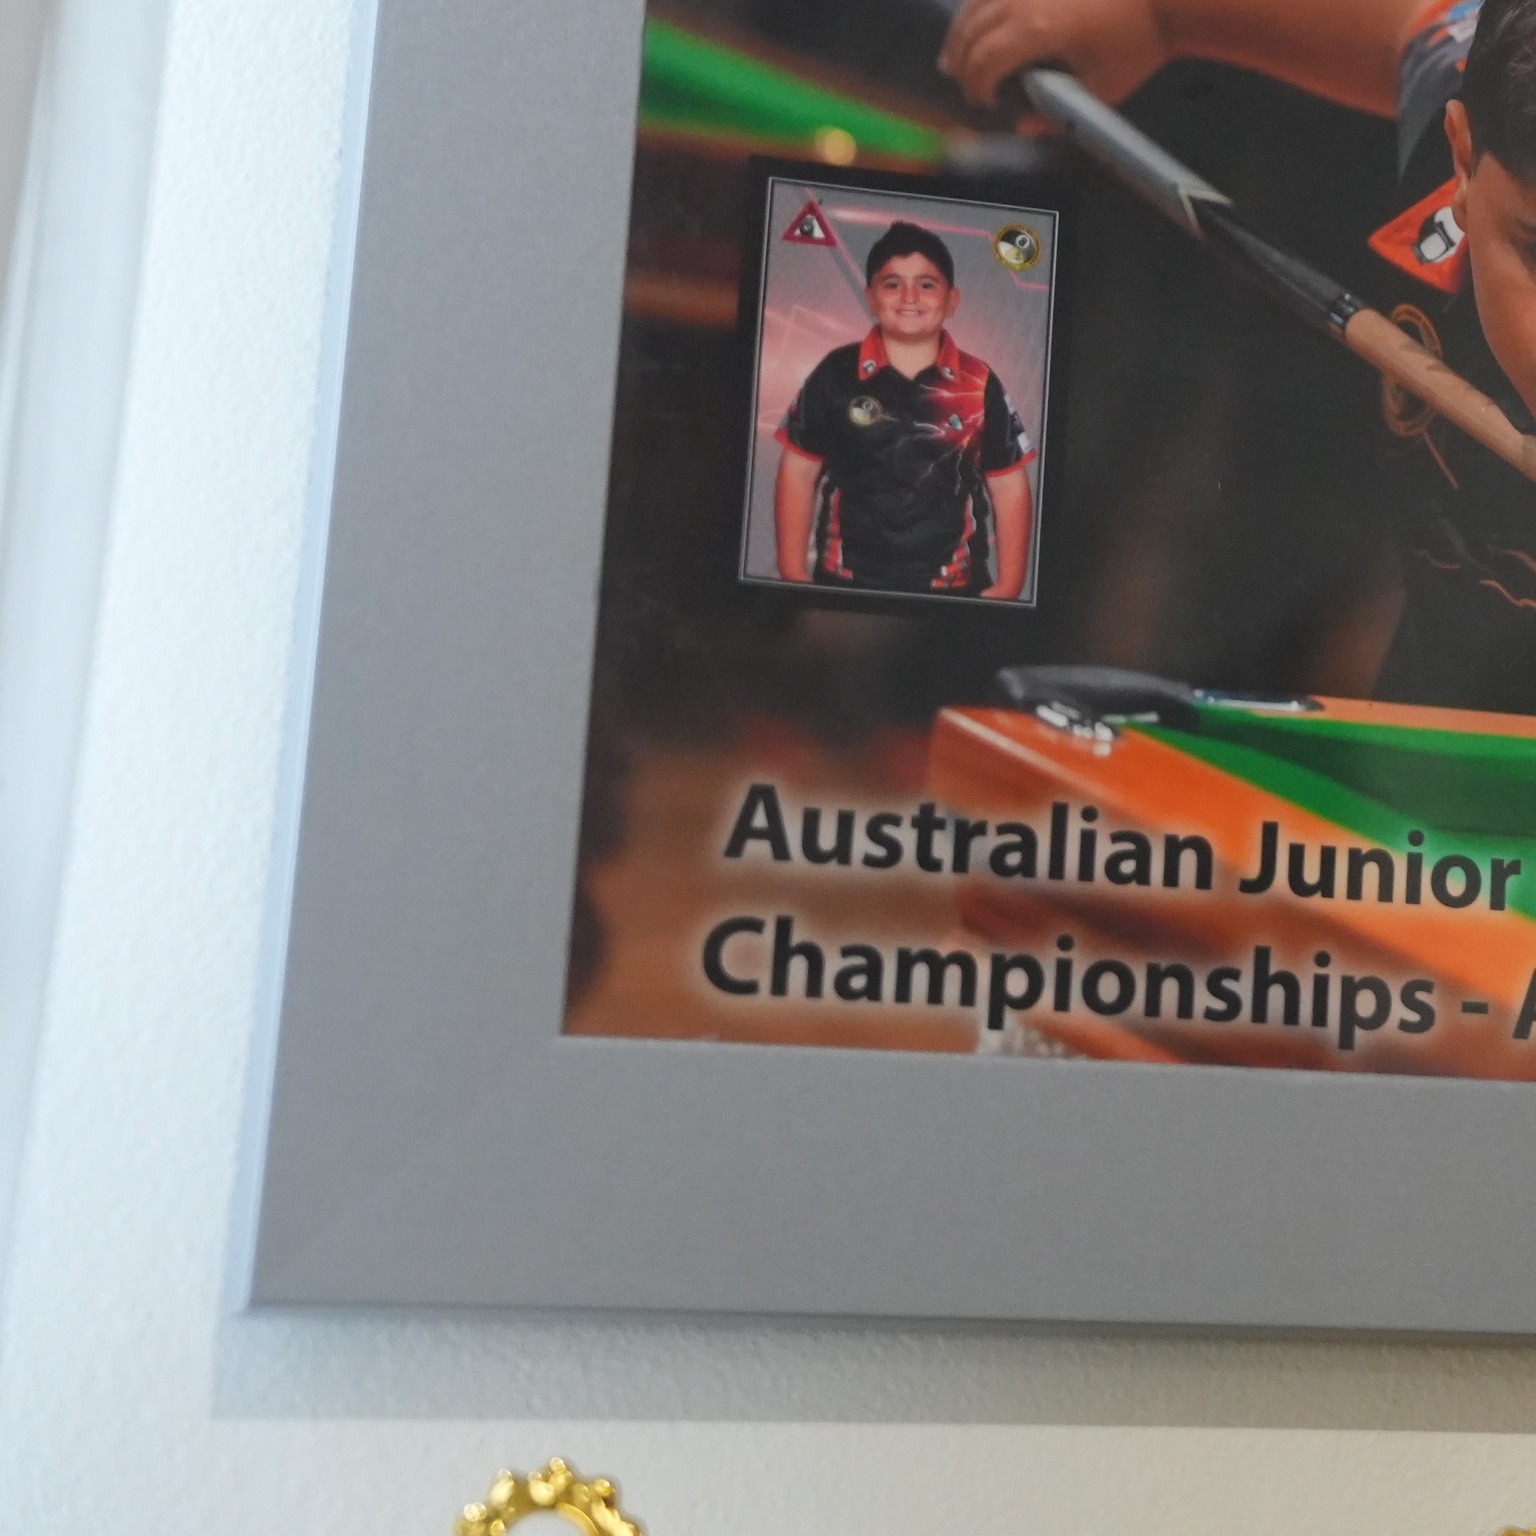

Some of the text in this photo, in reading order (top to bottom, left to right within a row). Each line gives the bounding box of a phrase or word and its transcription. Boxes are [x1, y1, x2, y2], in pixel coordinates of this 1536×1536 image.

[724, 783, 1215, 891] Australian
[1238, 821, 1523, 912] Junior
[701, 916, 1438, 1051] Championships
